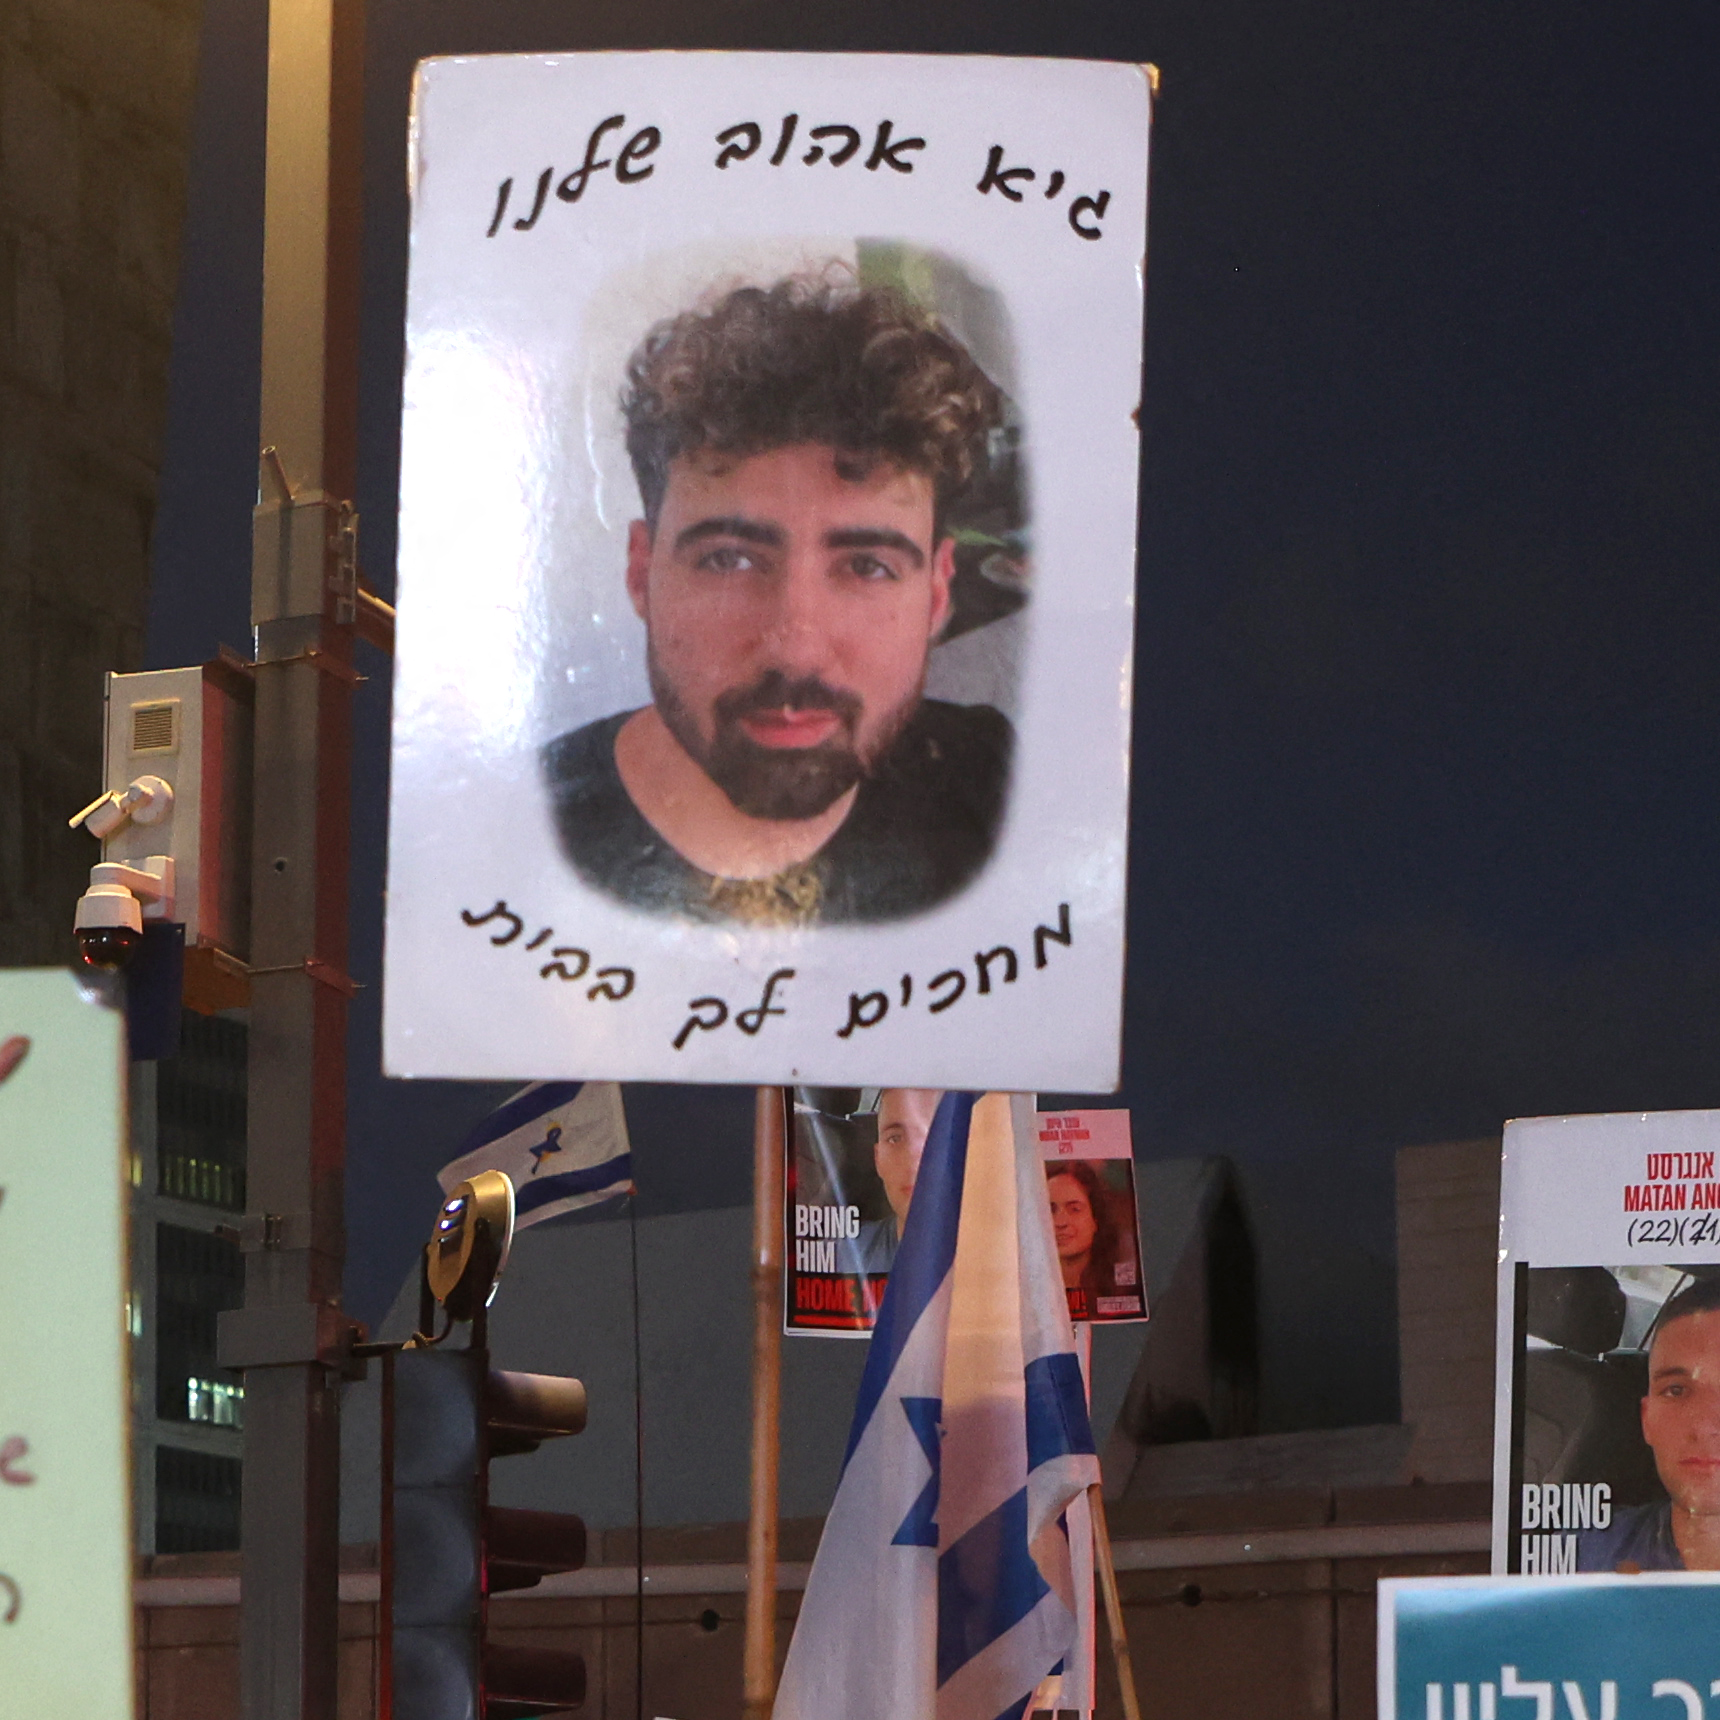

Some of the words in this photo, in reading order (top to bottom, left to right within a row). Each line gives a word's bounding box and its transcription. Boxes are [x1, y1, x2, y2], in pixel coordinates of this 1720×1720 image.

[714, 112, 928, 173] אהוב
[486, 113, 662, 238] שלנו
[978, 145, 1111, 241] גיא
[461, 900, 635, 1001] בבית
[836, 902, 1072, 1039] מחכים
[672, 968, 796, 1050] לך
[1646, 1151, 1716, 1181] אנגרסט
[795, 1204, 862, 1239] BRING
[1624, 1183, 1687, 1212] MATAN
[795, 1240, 838, 1273] HIM
[795, 1277, 856, 1311] HOME
[1521, 1482, 1613, 1530] BRING
[1521, 1534, 1577, 1575] HIM
